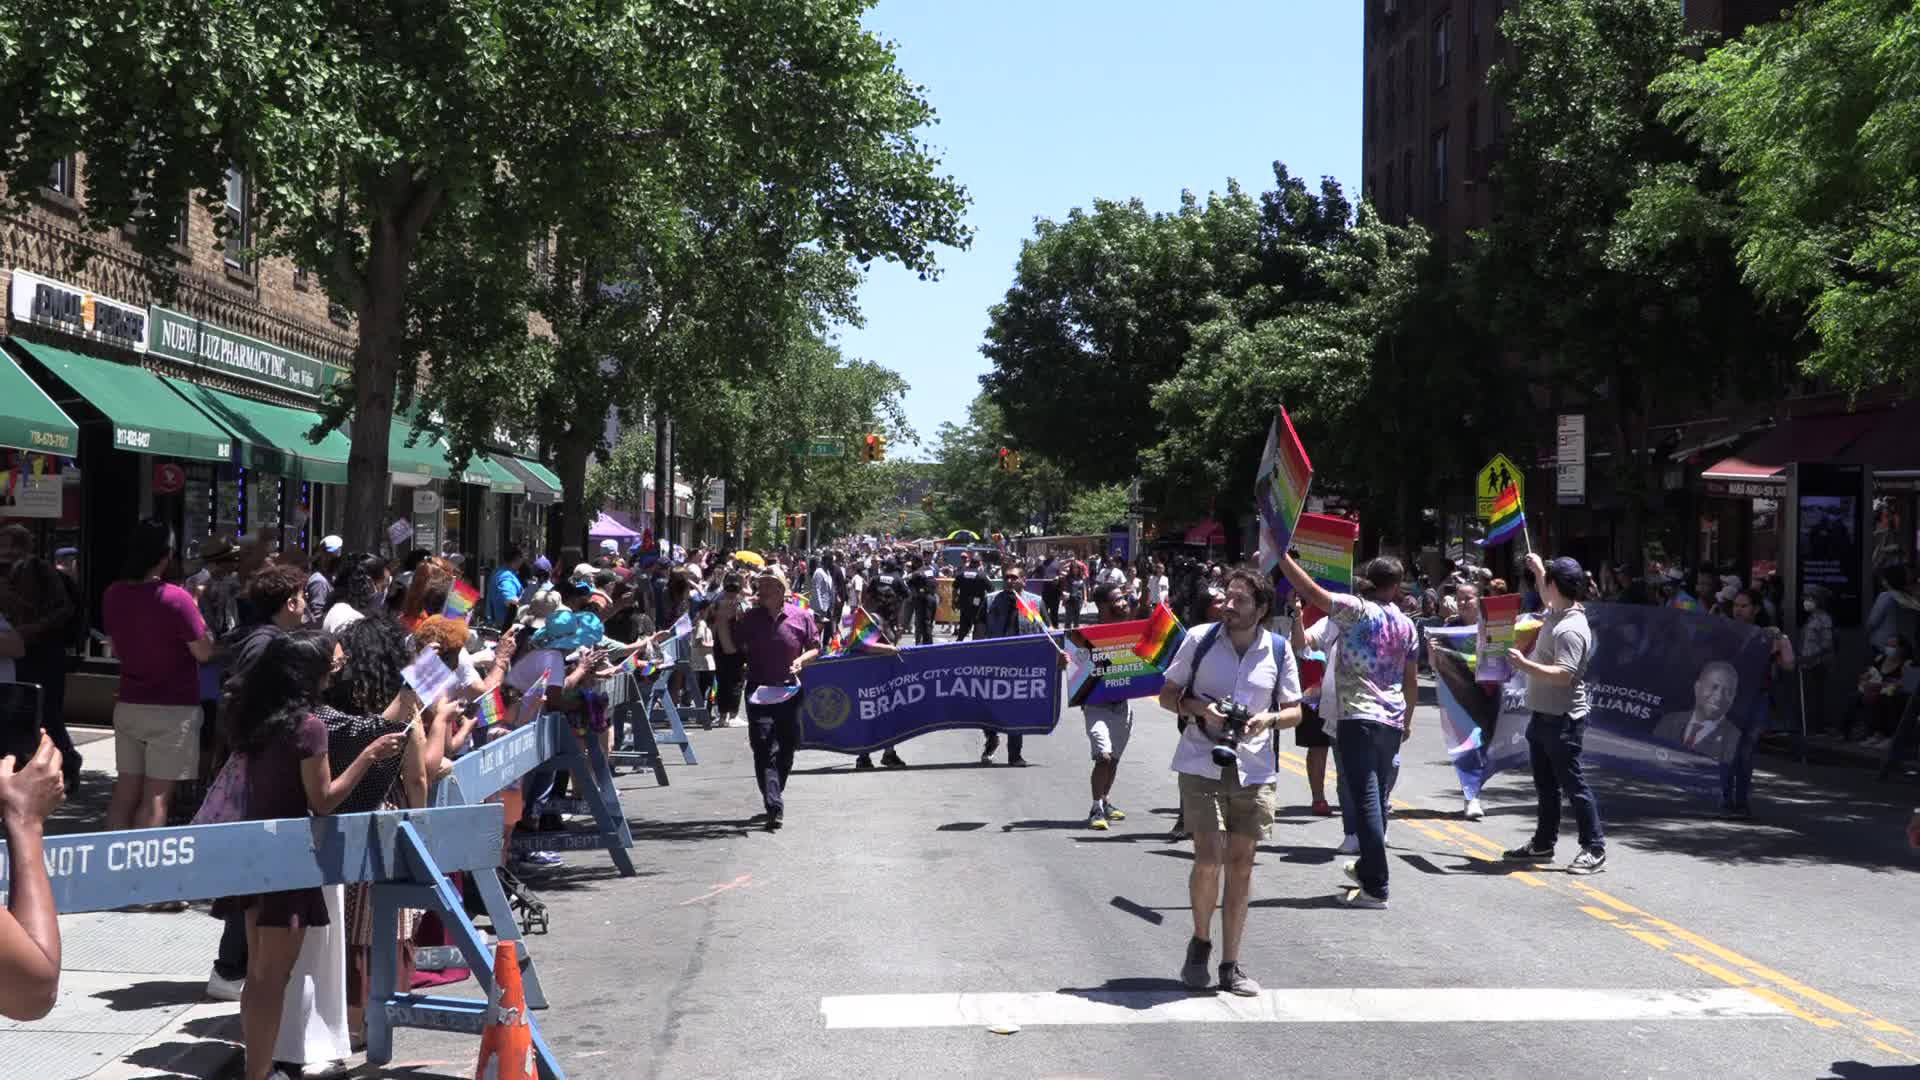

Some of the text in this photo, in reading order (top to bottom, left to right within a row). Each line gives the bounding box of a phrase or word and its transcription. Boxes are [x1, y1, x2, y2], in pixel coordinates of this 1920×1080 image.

[162, 320, 197, 353] NUEVA
[199, 333, 219, 361] LUZ
[221, 340, 270, 375] PHARMACY
[858, 666, 1047, 699] NEW YORK CITY COMPTROLLER
[1091, 661, 1144, 677] CELEBRATES
[1105, 677, 1131, 688] PRIDE
[859, 678, 1047, 720] BRAD LANDER
[43, 845, 95, 877] NOT
[108, 836, 195, 871] CROSS
